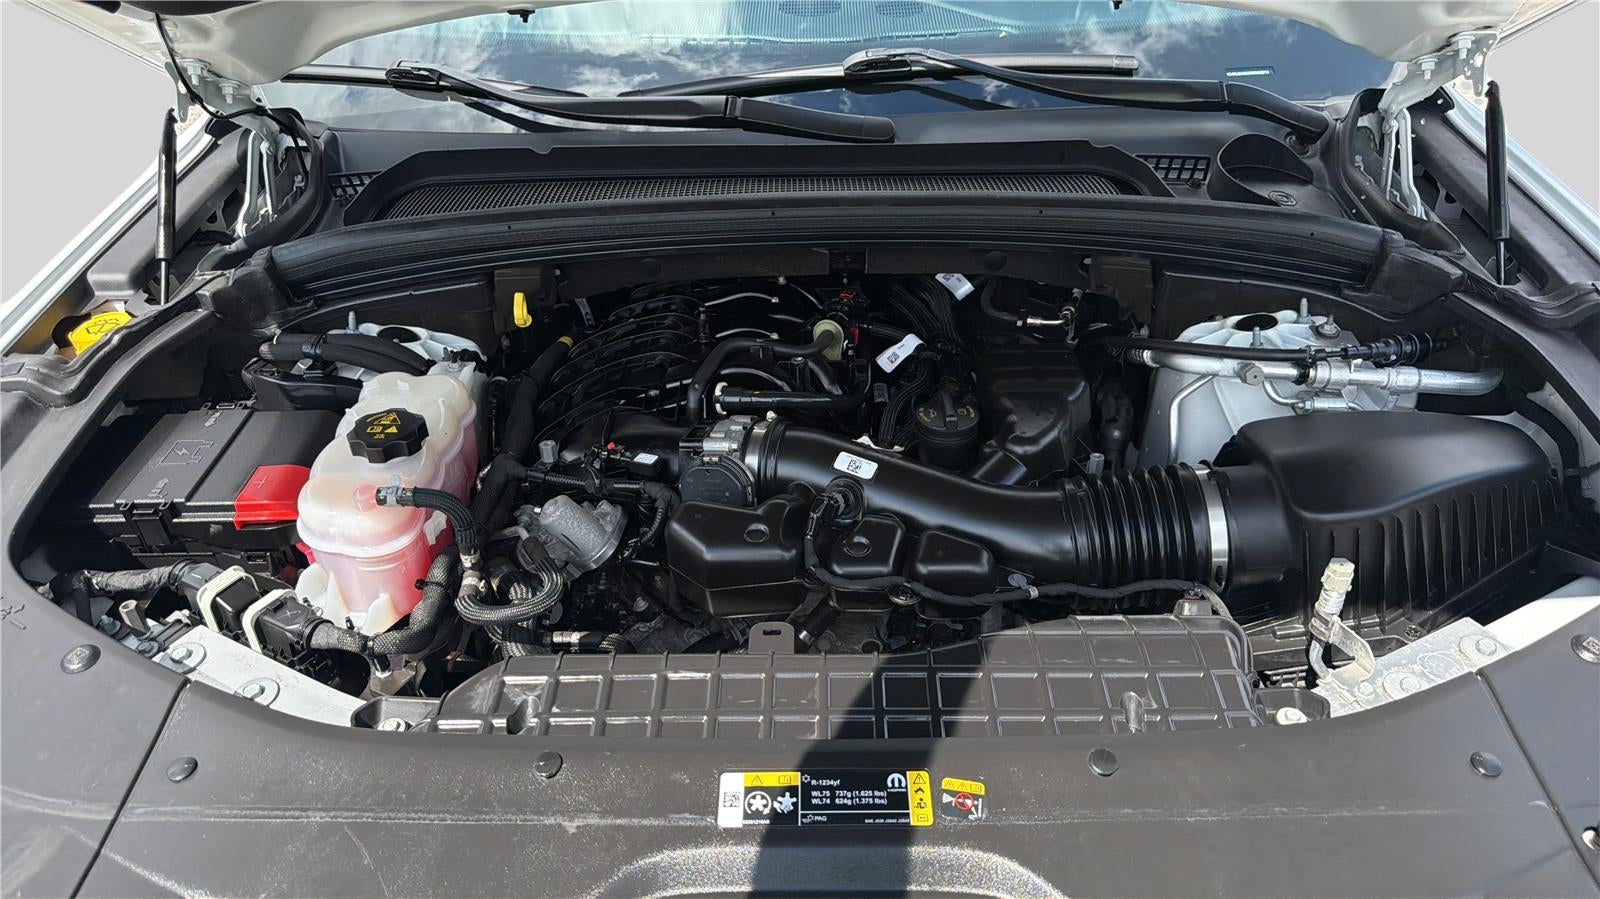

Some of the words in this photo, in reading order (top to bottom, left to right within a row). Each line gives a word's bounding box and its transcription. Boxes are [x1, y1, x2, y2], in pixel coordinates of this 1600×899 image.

[811, 779, 840, 787] R-1234yf
[835, 790, 852, 798] 737g
[852, 790, 873, 798] (1.625
[873, 790, 887, 798] lbs)
[835, 798, 852, 806] 624g
[853, 798, 873, 806] (1.375
[874, 798, 888, 806] lbs)
